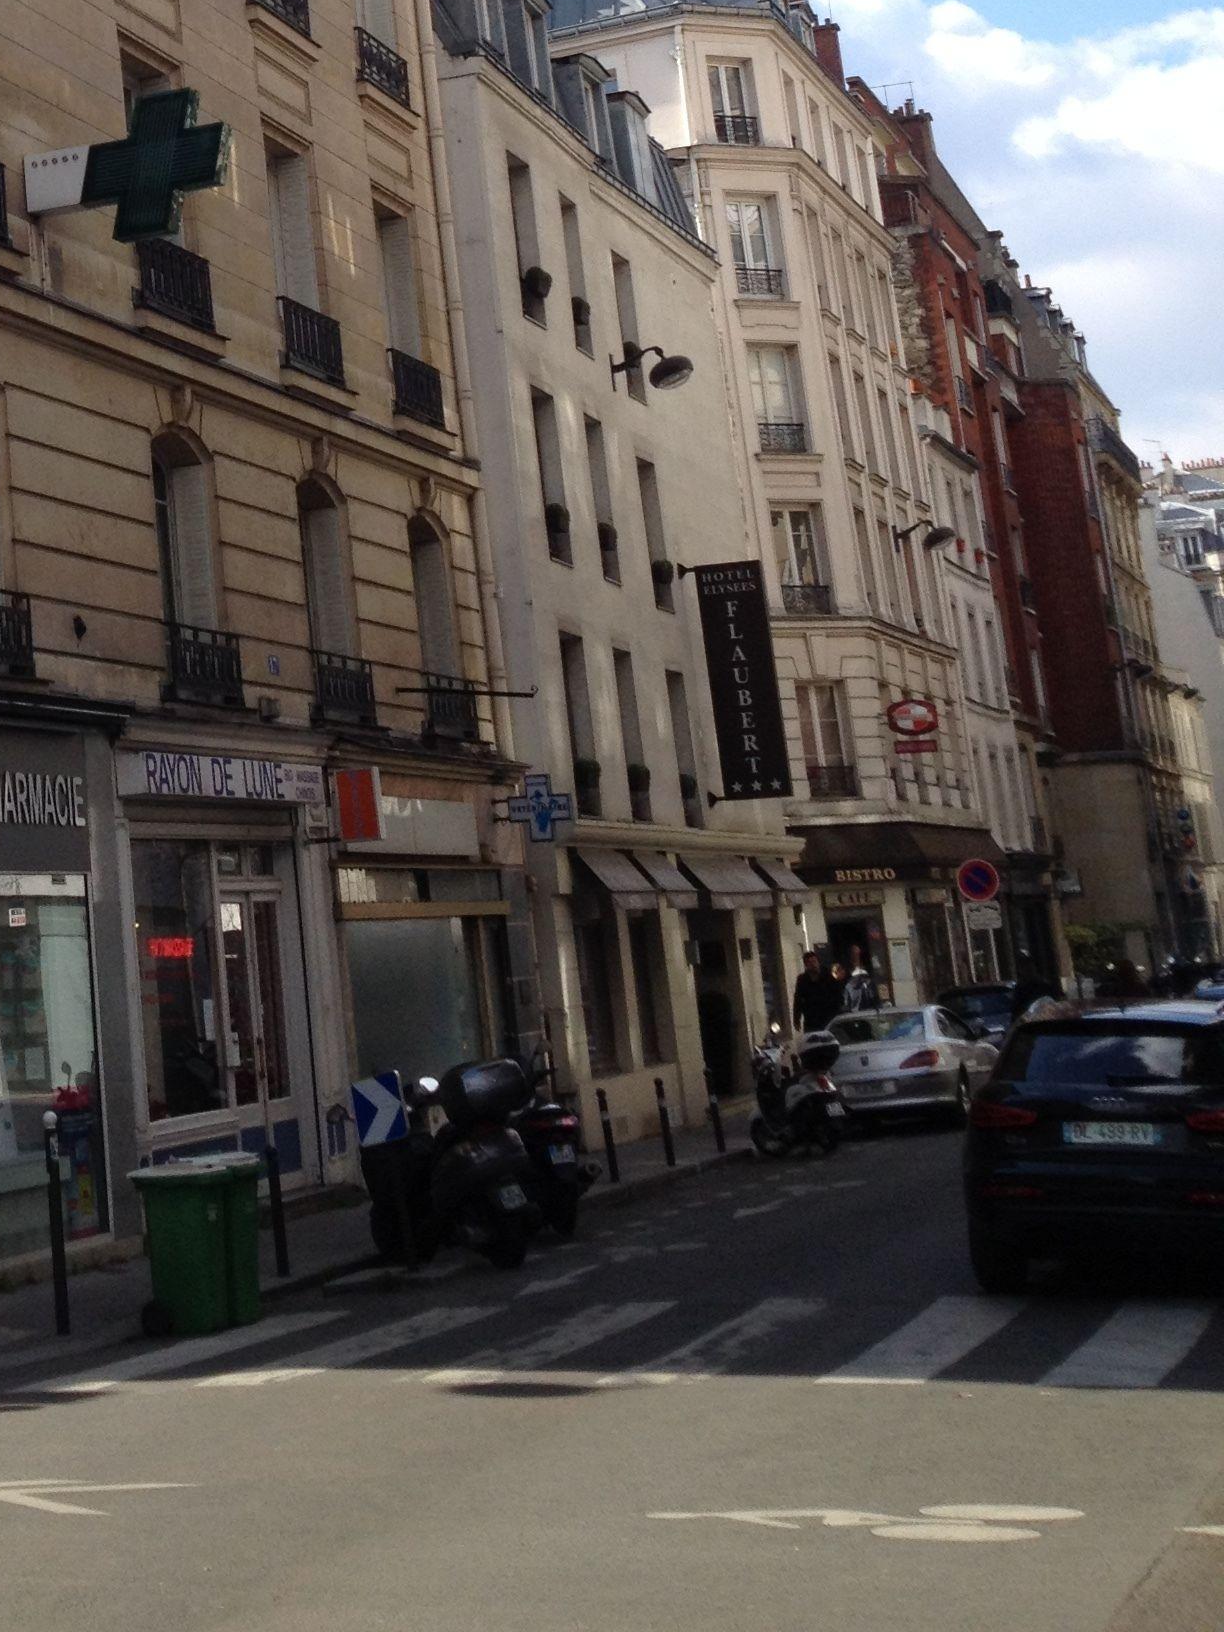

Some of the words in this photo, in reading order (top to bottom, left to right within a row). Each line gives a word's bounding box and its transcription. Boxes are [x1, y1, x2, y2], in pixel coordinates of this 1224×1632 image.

[701, 569, 754, 583] HOTEL
[703, 582, 756, 595] ELYSEES
[726, 600, 761, 774] FLAUBERT
[146, 753, 203, 795] RAYON
[211, 757, 236, 796] DE
[242, 761, 285, 800] LUNE
[835, 869, 896, 882] BISTRO
